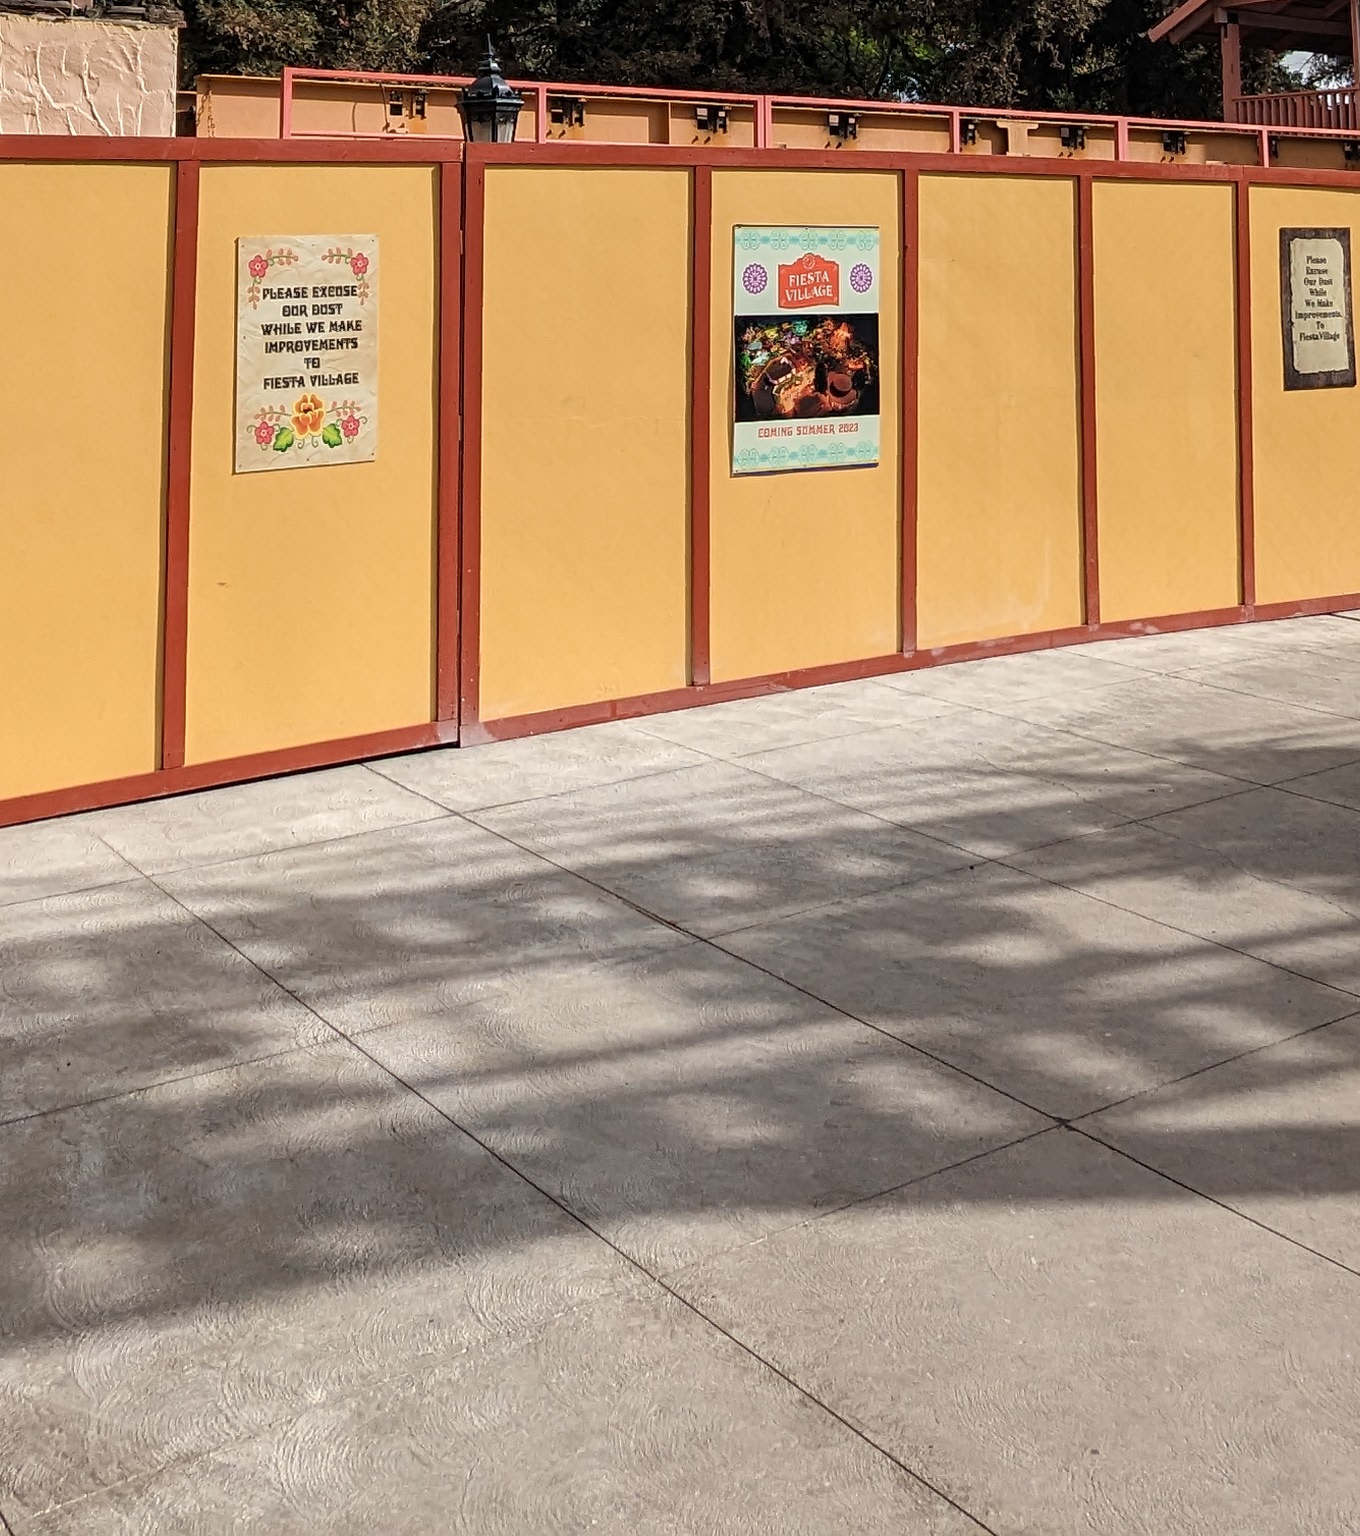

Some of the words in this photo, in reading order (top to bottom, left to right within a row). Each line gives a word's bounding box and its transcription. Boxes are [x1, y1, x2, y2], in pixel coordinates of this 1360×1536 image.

[1306, 256, 1326, 264] Please
[789, 271, 830, 287] FIESTA
[262, 286, 308, 300] PLEASE
[312, 285, 358, 298] EXCUSE
[785, 285, 833, 302] VILLAGE
[282, 305, 309, 317] OUR
[312, 303, 343, 315] DUST
[1305, 299, 1315, 307] We
[261, 322, 302, 336] WHILE
[306, 321, 325, 334] WE
[329, 320, 362, 332] MAKE
[1316, 321, 1324, 329] To
[264, 338, 358, 354] IMPROVEMENTS
[303, 357, 321, 369] TO
[263, 376, 305, 390] FIESTA
[310, 373, 359, 386] VILLAGE
[758, 426, 793, 438] COMING
[796, 424, 836, 436] SUMMER
[838, 422, 859, 433] 2023
